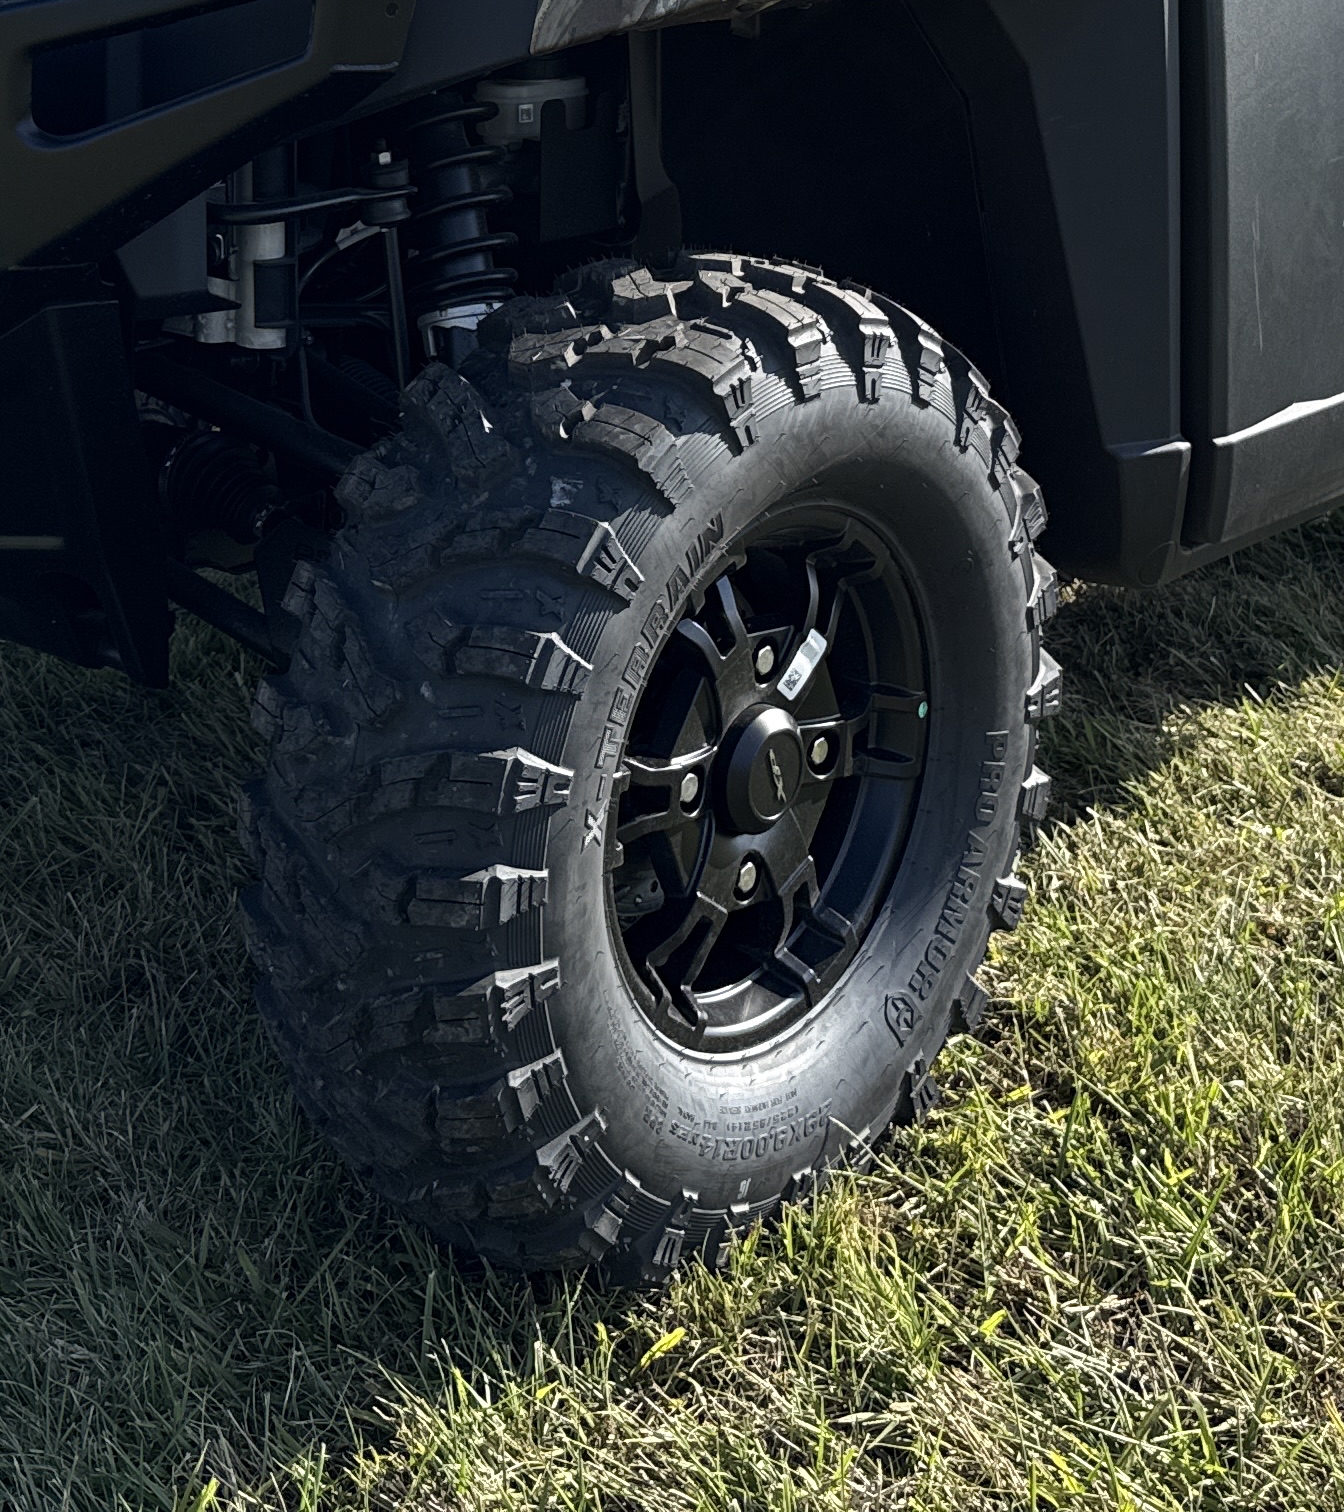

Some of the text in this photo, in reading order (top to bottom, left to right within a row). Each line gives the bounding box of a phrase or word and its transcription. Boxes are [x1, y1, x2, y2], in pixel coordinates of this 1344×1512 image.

[580, 509, 725, 855] X-TERRAIN
[908, 729, 1010, 1002] PRO ARMOR
